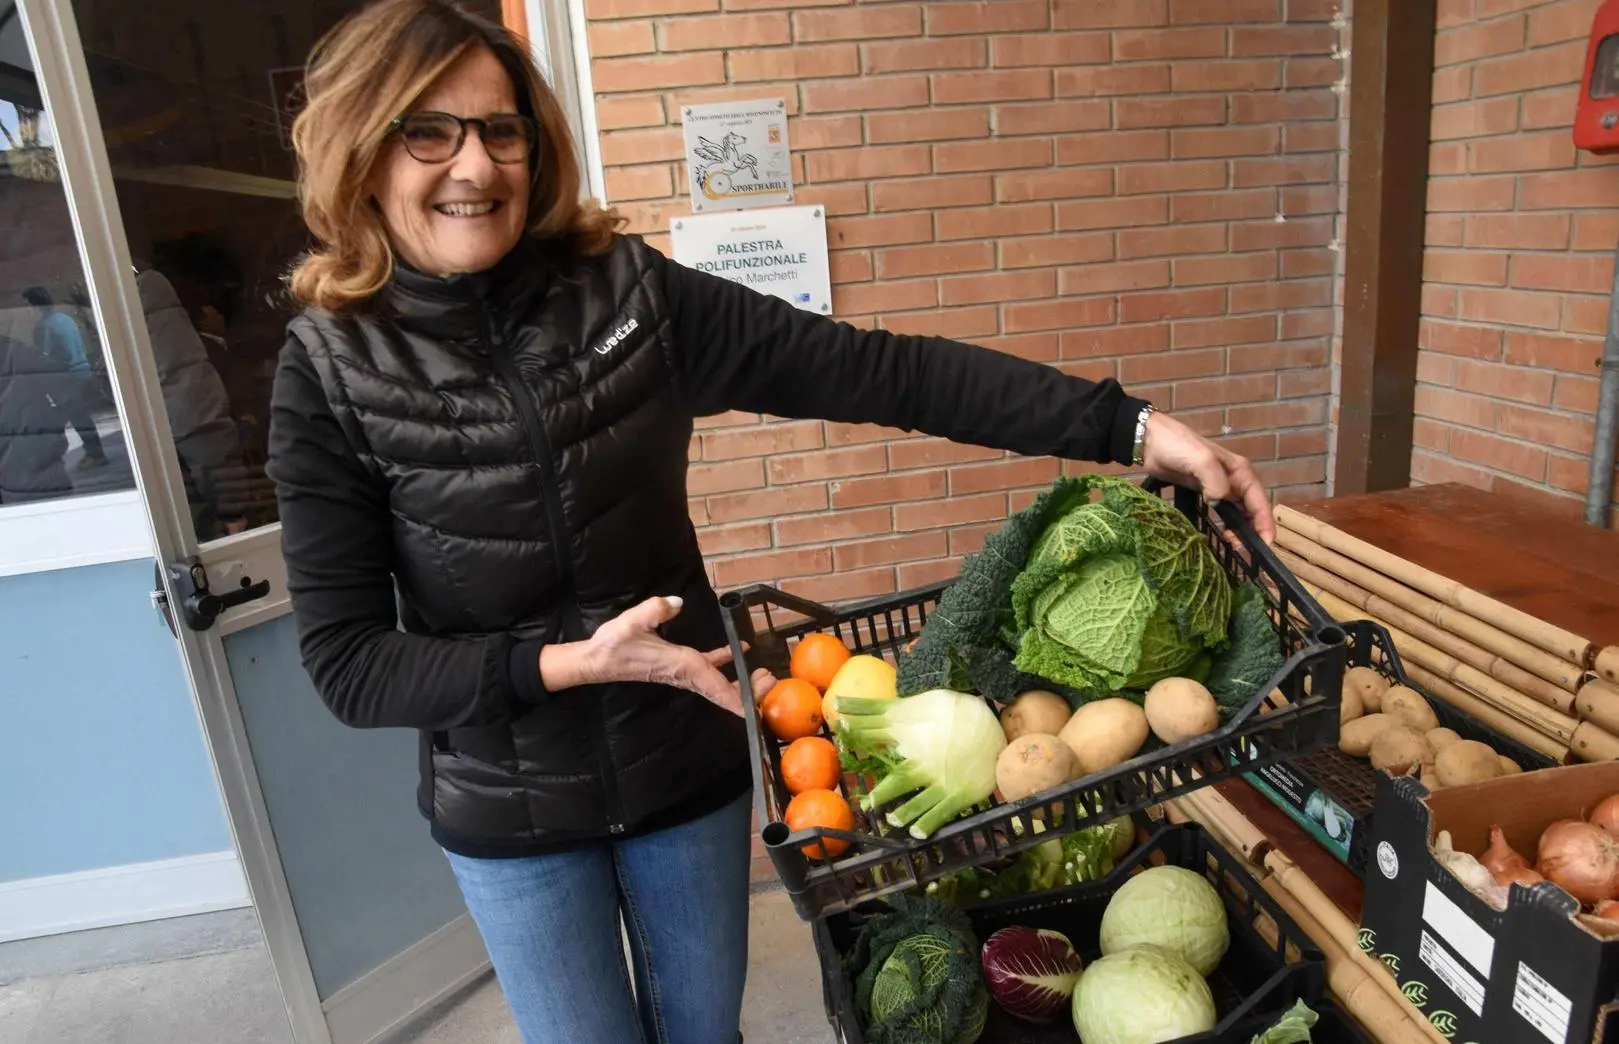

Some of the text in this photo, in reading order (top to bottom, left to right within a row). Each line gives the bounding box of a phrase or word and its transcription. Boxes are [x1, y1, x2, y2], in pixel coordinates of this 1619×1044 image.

[717, 239, 783, 255] PALESTRA
[695, 252, 808, 272] POLIFUNZIONALE
[746, 269, 798, 284] Marchetti
